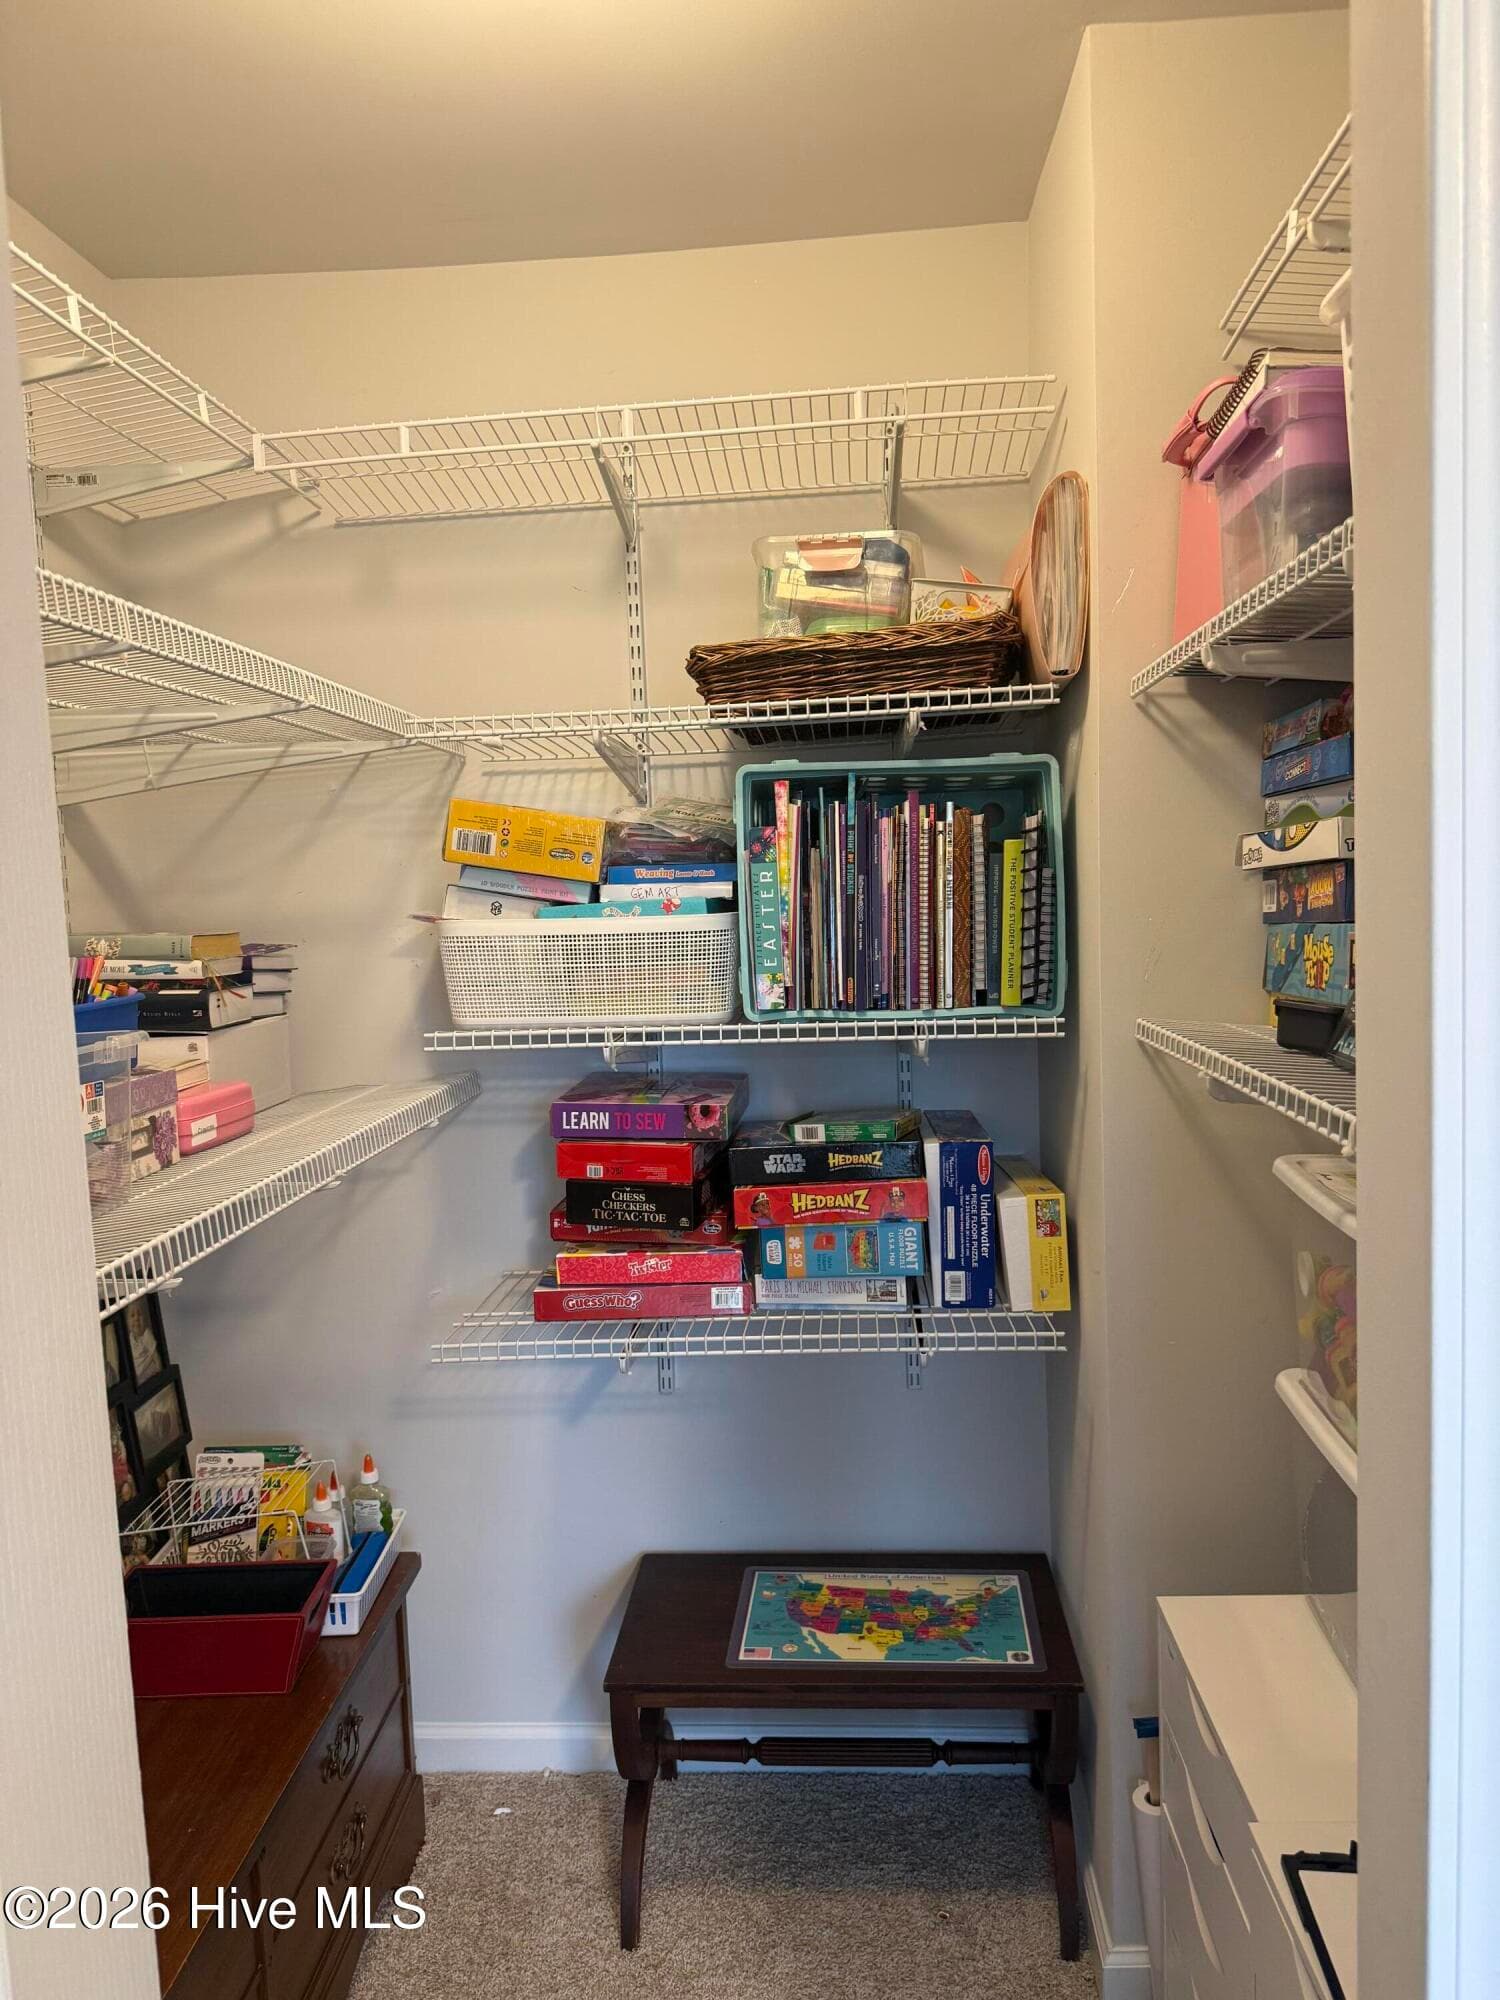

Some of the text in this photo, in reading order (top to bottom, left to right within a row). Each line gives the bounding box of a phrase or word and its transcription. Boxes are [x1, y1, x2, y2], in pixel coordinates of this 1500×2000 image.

[634, 868, 675, 879] Weaving
[631, 886, 679, 899] GEM ART
[1009, 875, 1017, 911] POSITIVE
[760, 871, 777, 967] EASTER
[1008, 913, 1016, 950] STUDENT
[1303, 933, 1334, 965] Mouse
[1007, 952, 1015, 989] PLANNER
[562, 1111, 666, 1131] LEARN TO SEW
[763, 1153, 806, 1174] STAR WARS
[827, 1150, 883, 1168] HEDBANZ
[601, 1200, 656, 1212] CHECKERS
[611, 1190, 646, 1202] CHESS
[791, 1187, 871, 1214] HEDBANZ
[980, 1193, 991, 1258] Underwater
[904, 1226, 919, 1270] GIANT
[628, 1258, 672, 1277] Twister
[793, 1253, 803, 1267] 50
[761, 1279, 780, 1293] PARIS
[784, 1279, 793, 1293] BY
[797, 1280, 823, 1294] MICHAEL
[191, 1514, 246, 1538] MARKERS
